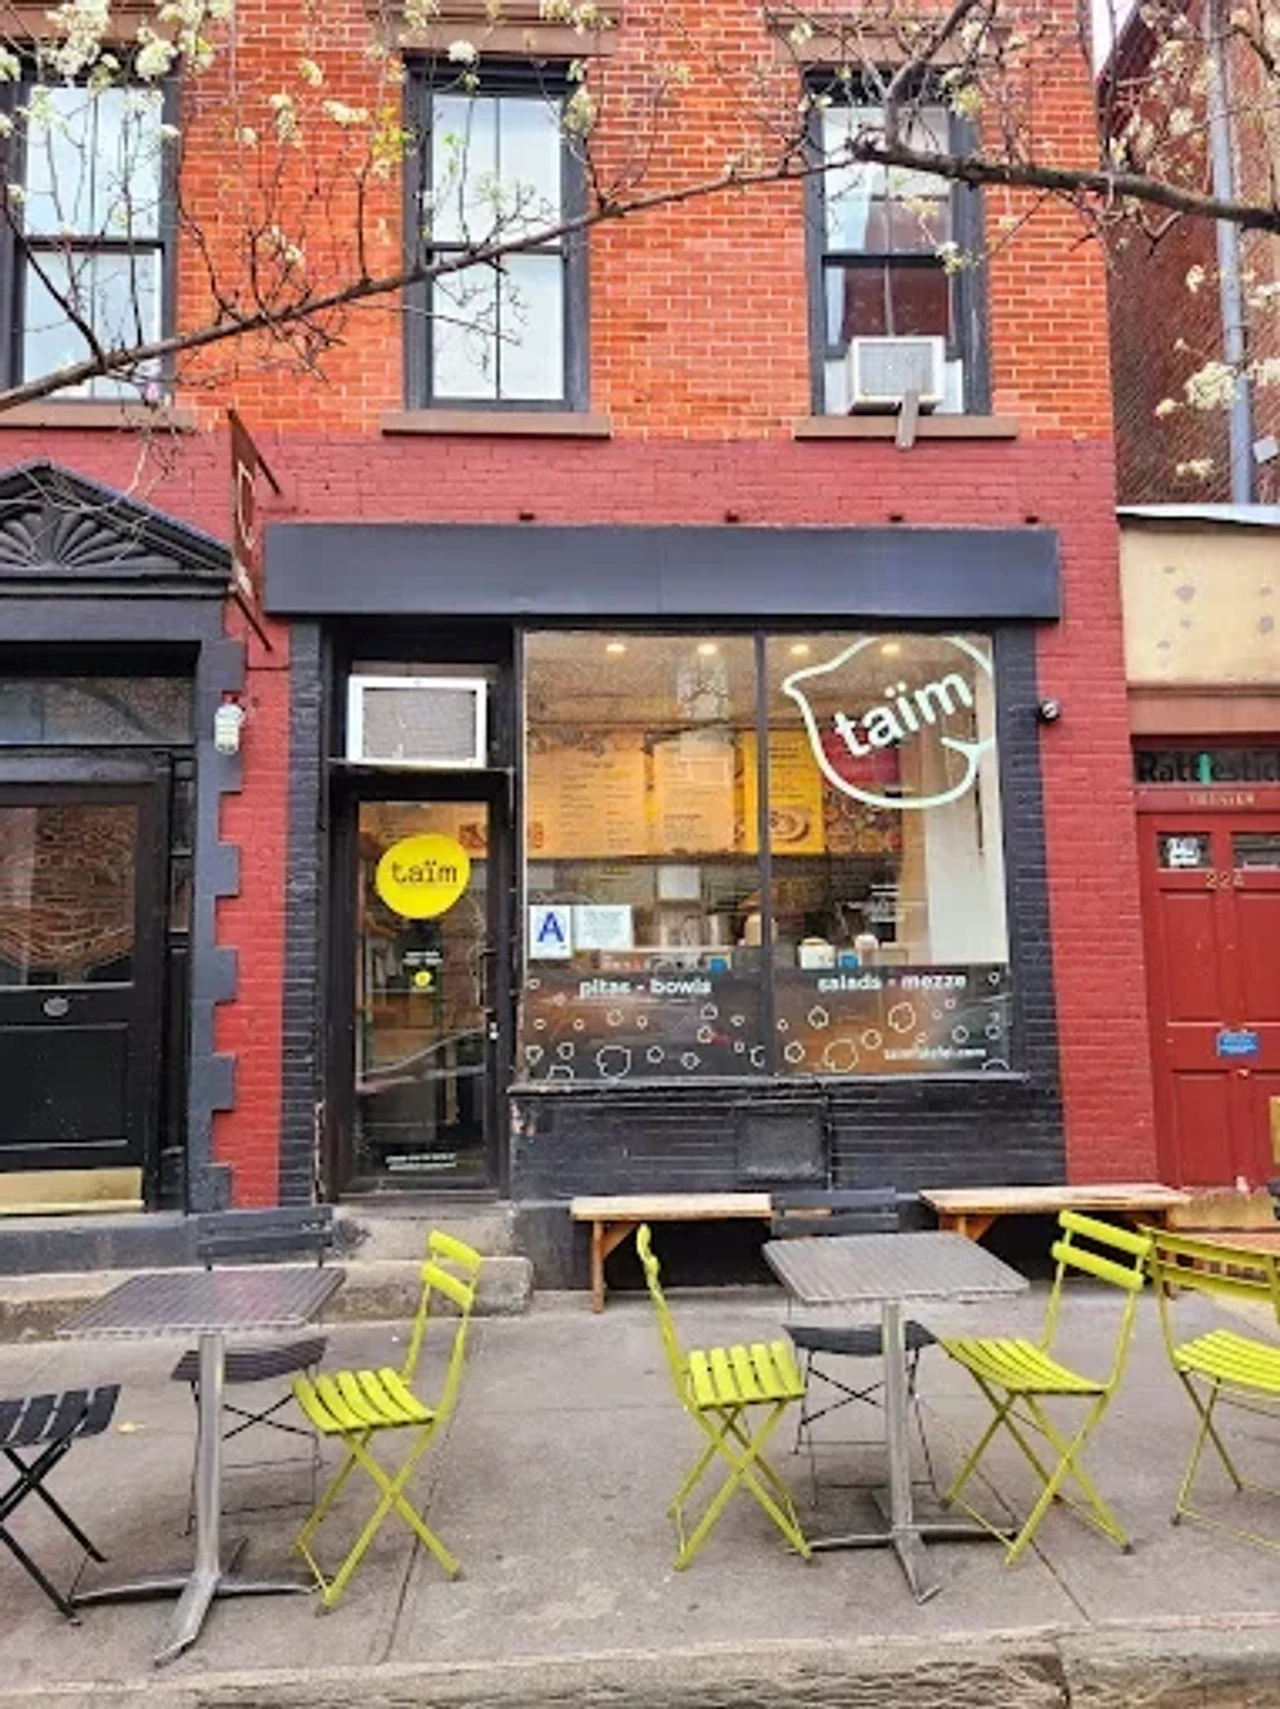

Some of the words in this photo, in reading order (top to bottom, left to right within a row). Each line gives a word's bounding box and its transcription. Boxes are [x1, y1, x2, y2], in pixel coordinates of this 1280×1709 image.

[834, 673, 973, 756] taïm
[391, 859, 457, 883] taïm
[537, 911, 564, 942] A
[579, 978, 632, 999] pitas
[650, 978, 712, 994] bowls
[817, 974, 882, 991] salads
[902, 974, 967, 990] mezze
